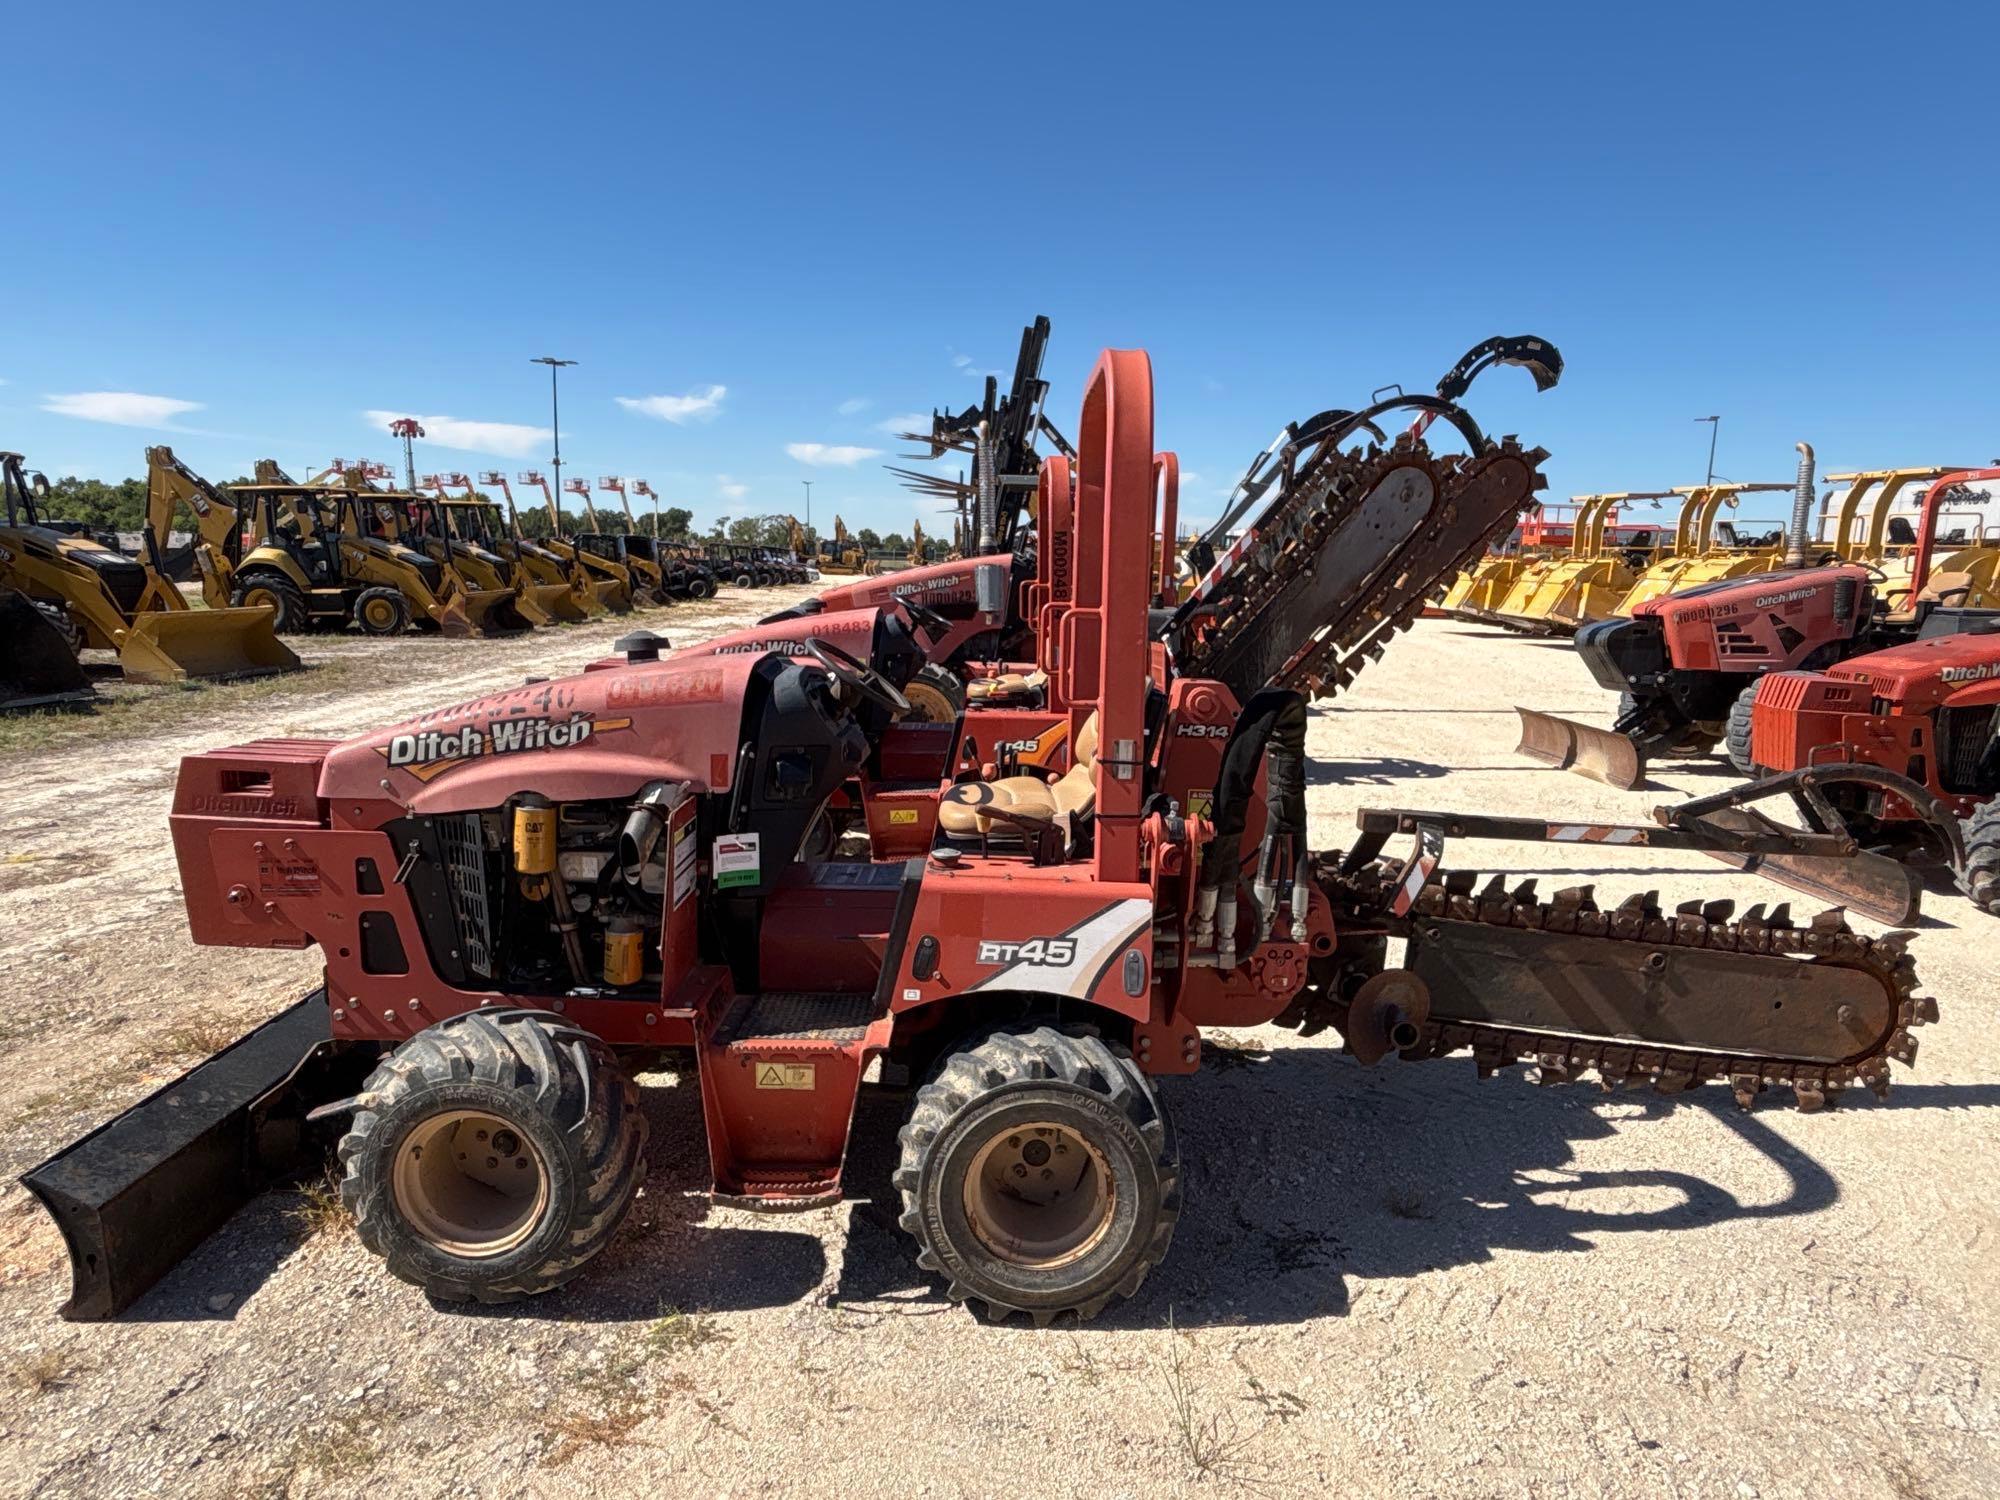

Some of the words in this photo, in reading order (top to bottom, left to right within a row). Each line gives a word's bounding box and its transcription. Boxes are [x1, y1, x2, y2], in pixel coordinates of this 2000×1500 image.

[928, 575, 959, 590] Witch
[1054, 531, 1068, 619] M000484
[1756, 594, 1786, 608] Ditch
[1788, 586, 1817, 601] Witch
[811, 620, 871, 636] 018483
[1941, 664, 1987, 682] Ditch
[390, 726, 481, 765] Ditch
[491, 714, 591, 752] Witch
[1177, 724, 1229, 738] H314
[525, 822, 545, 833] CAT
[980, 940, 1074, 964] RT45
